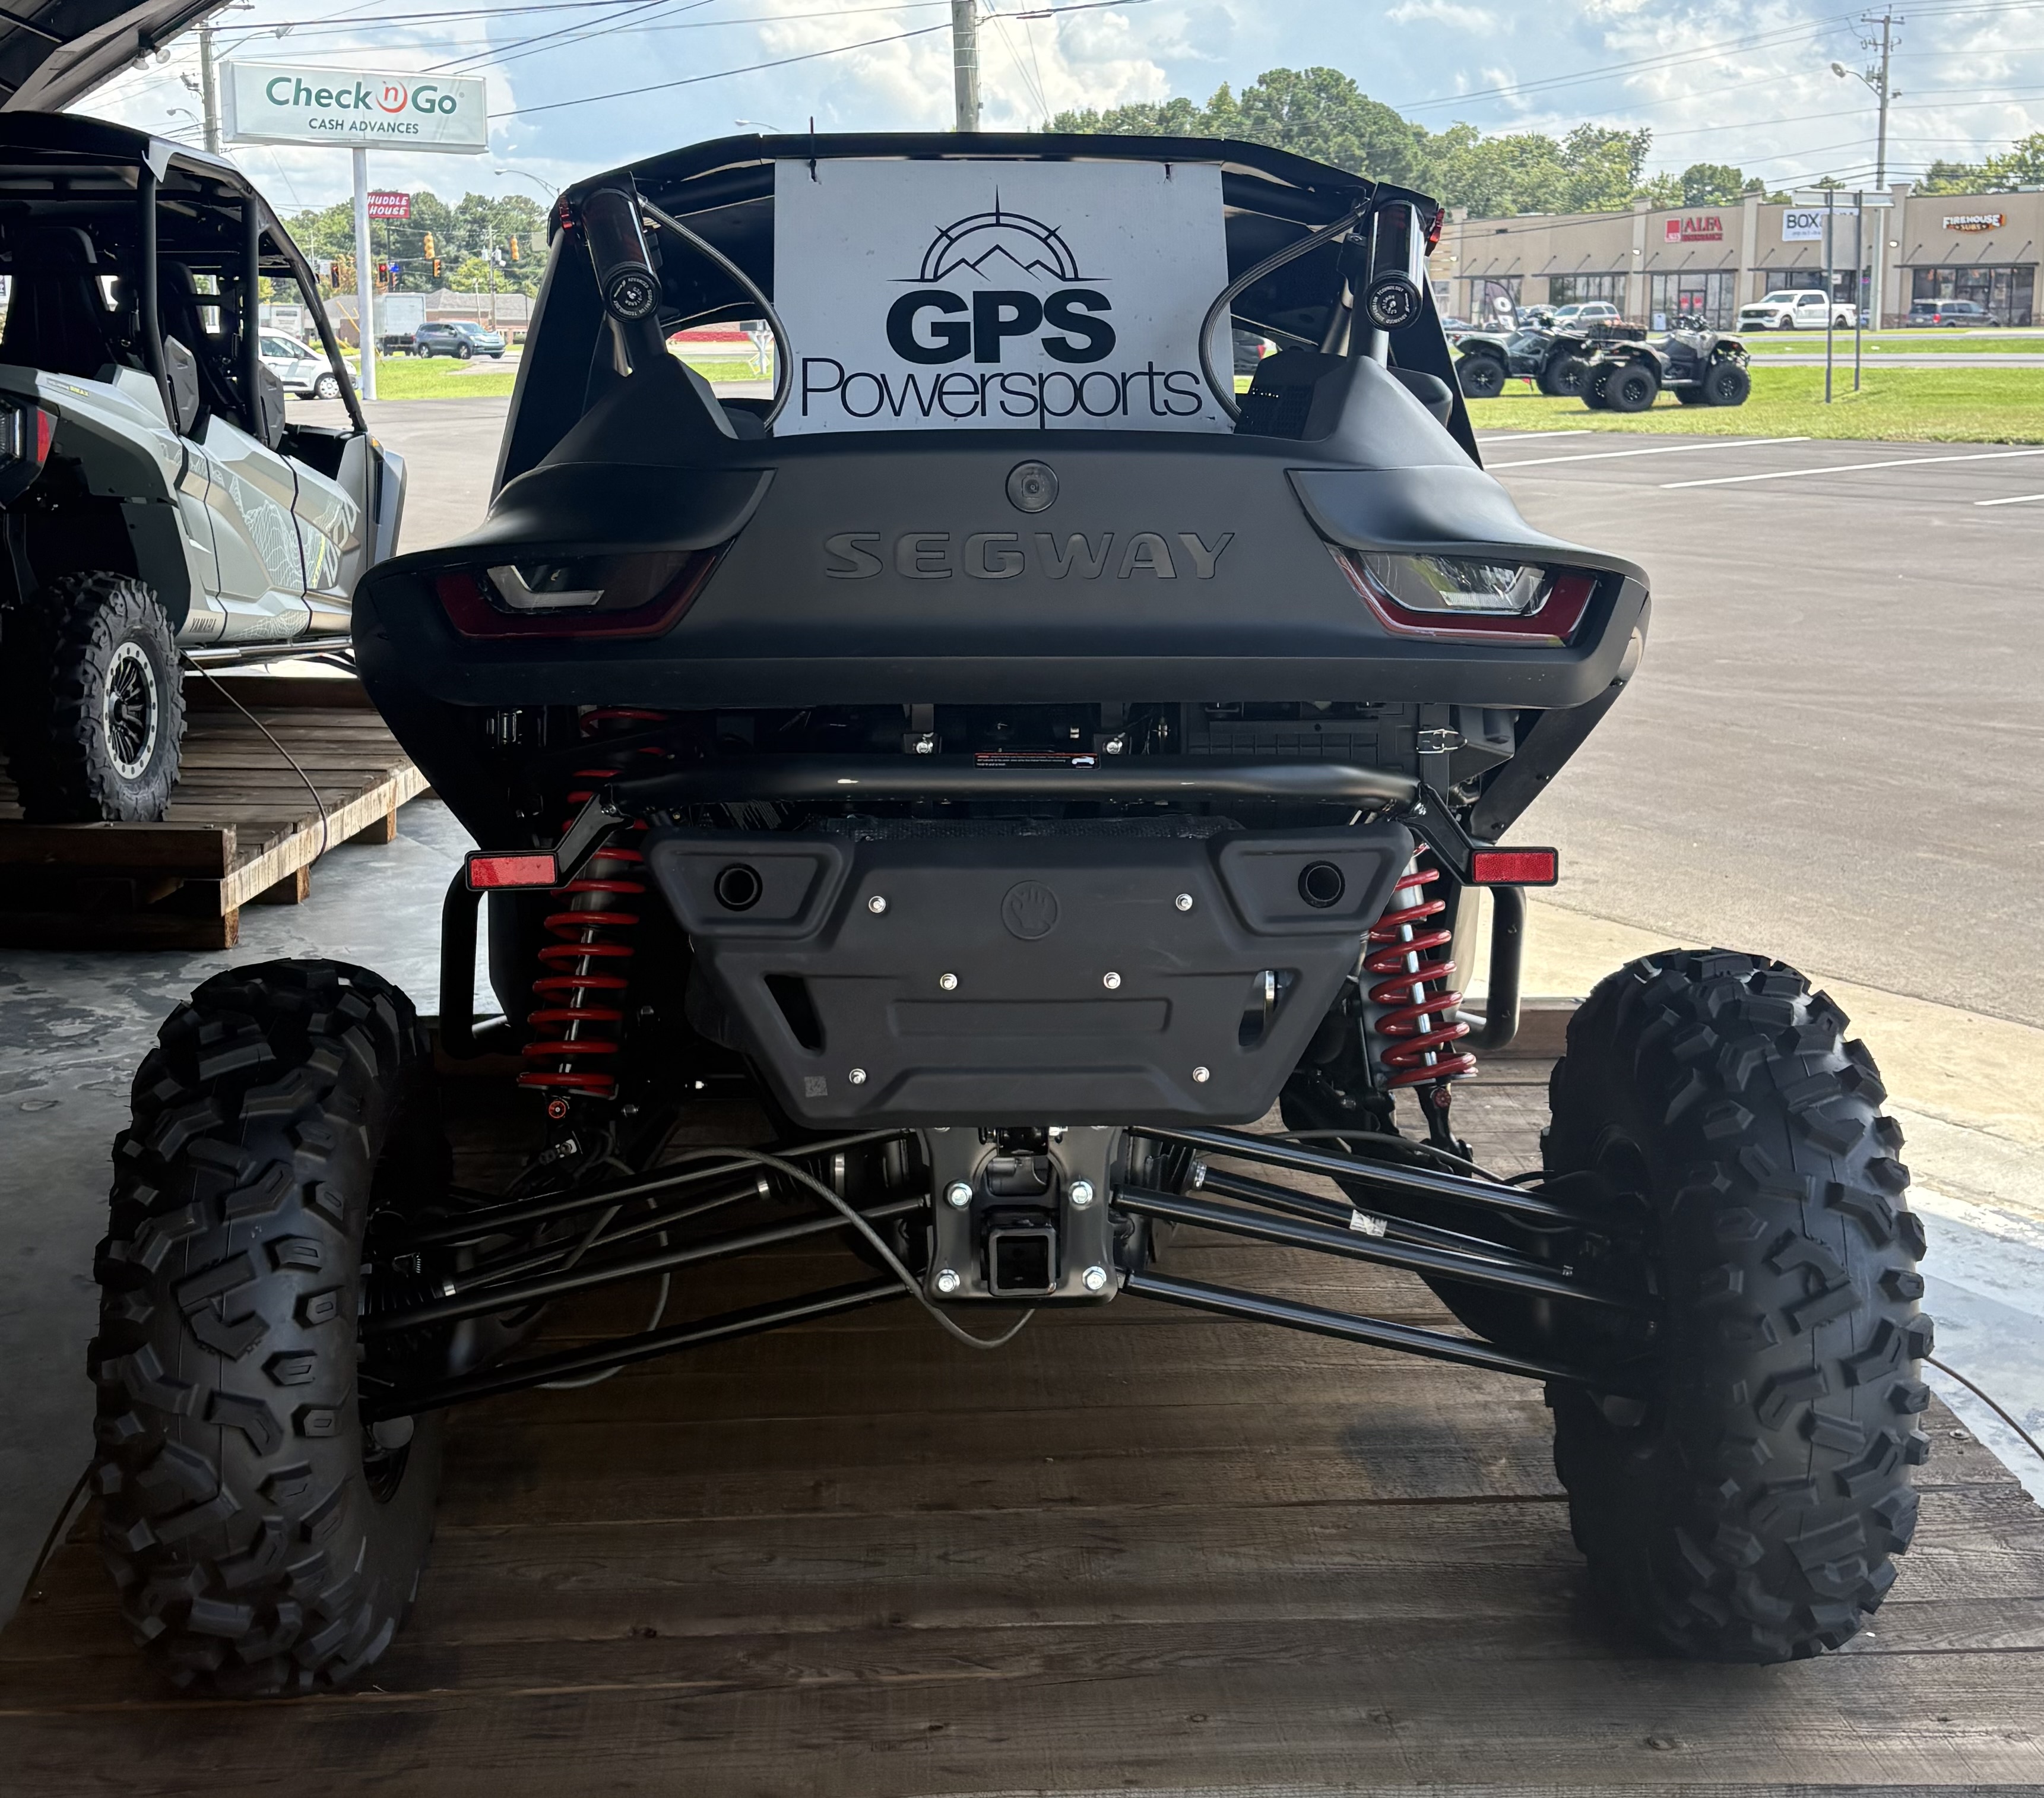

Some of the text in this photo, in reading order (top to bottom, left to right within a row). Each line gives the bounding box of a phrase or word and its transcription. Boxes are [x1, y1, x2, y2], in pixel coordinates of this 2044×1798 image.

[265, 76, 373, 110] Check
[411, 85, 458, 115] Go
[308, 118, 419, 134] CASH ADVANCES
[367, 195, 408, 205] HUDDLE
[369, 205, 408, 216] HOUSE
[1684, 216, 1723, 233] ALFA
[1942, 214, 2001, 229] FIREHOUSE
[886, 289, 1117, 365] GPS
[801, 357, 1203, 430] Powersports
[825, 531, 1235, 580] SEGWAY
[189, 617, 217, 634] YAMAHA
